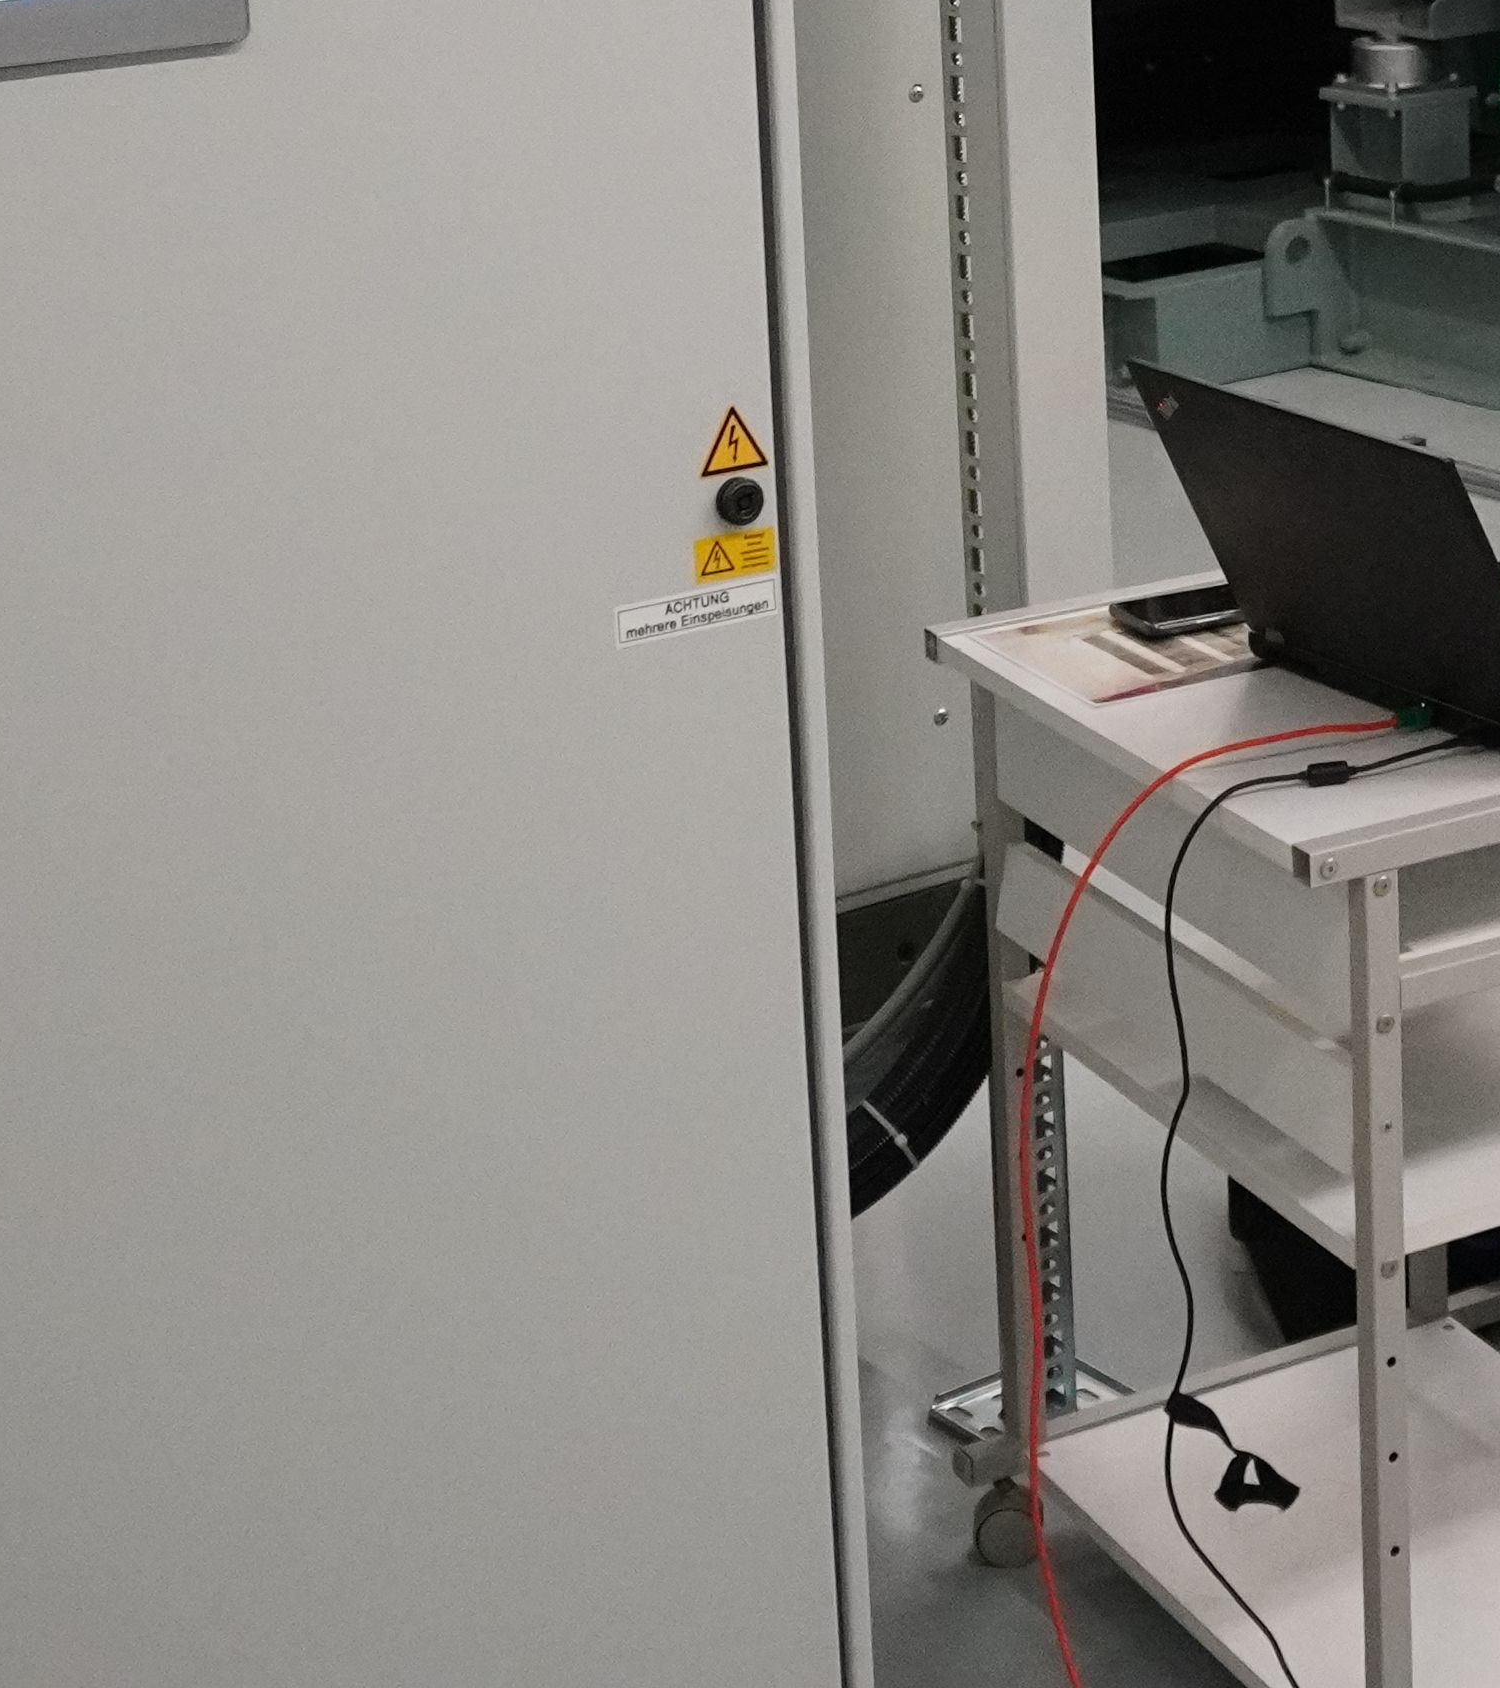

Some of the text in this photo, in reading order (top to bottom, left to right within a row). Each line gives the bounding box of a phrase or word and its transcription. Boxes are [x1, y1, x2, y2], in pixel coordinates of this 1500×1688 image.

[625, 598, 770, 640] mehrere Einspeisungen
[664, 590, 731, 616] ACHTUNG
